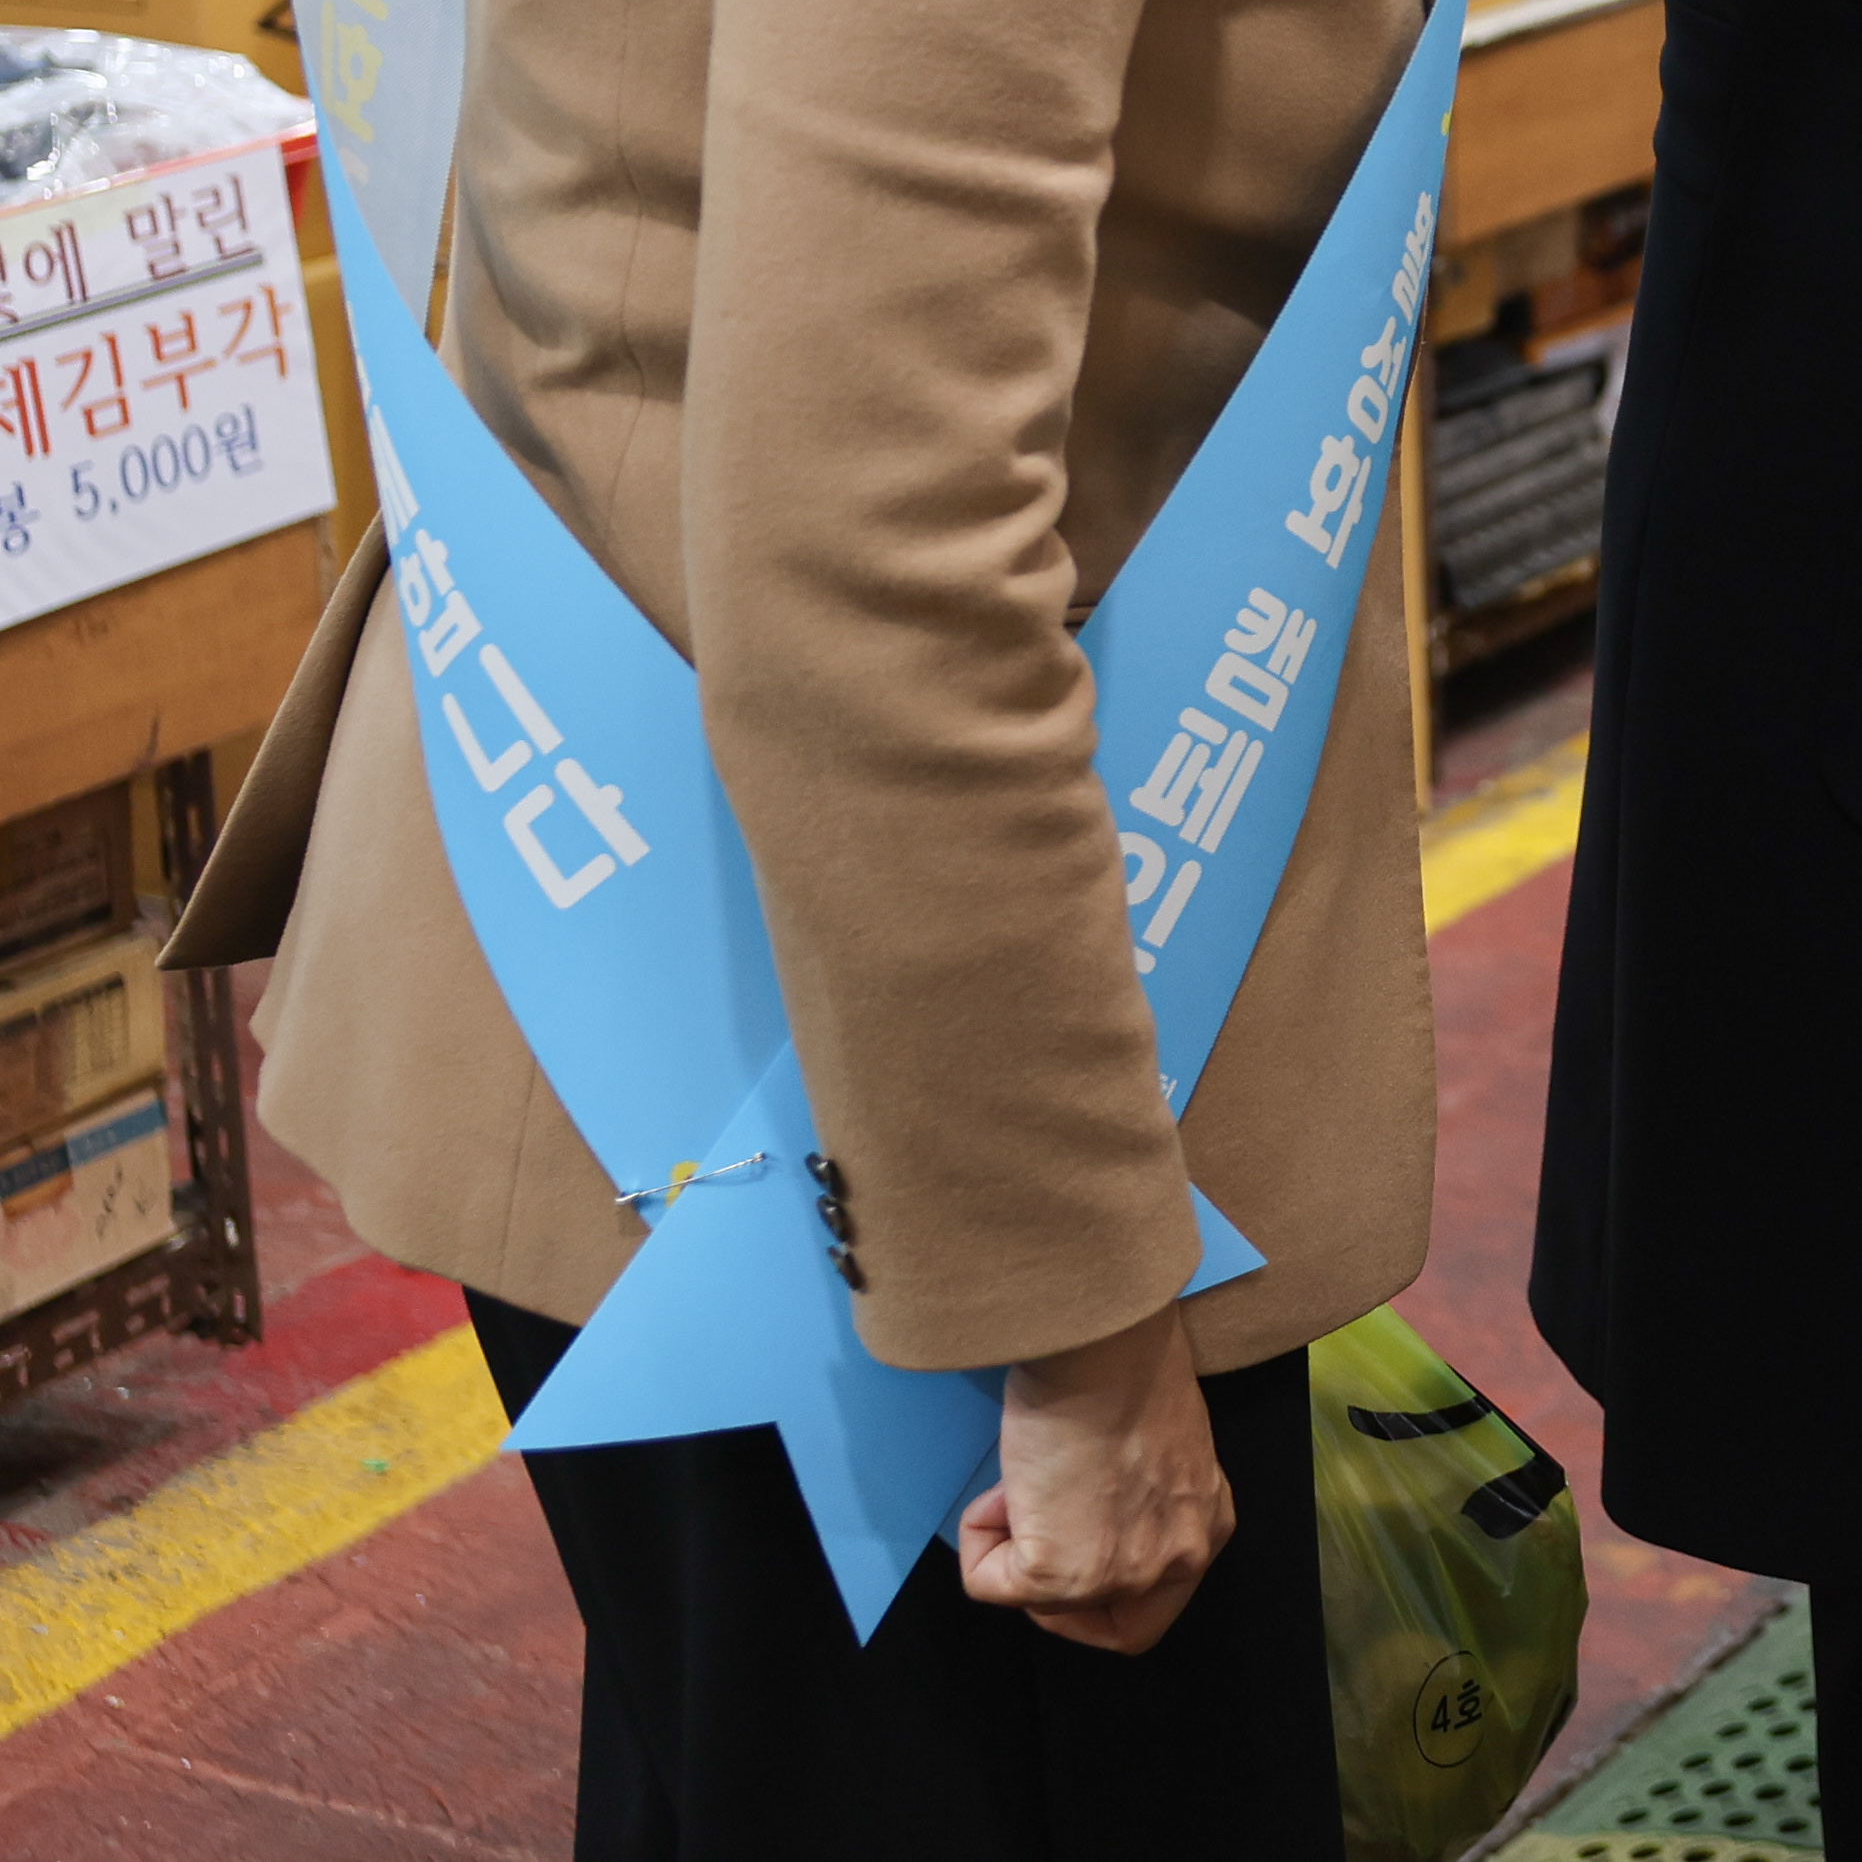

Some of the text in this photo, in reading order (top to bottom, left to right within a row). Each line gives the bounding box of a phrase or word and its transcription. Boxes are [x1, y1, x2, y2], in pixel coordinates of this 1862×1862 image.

[124, 170, 258, 281] 말린
[71, 403, 263, 523] 5,000원
[349, 348, 651, 909] 합니다
[1122, 192, 1435, 975] 활성화 캠페인
[1430, 1679, 1484, 1734] 4호
